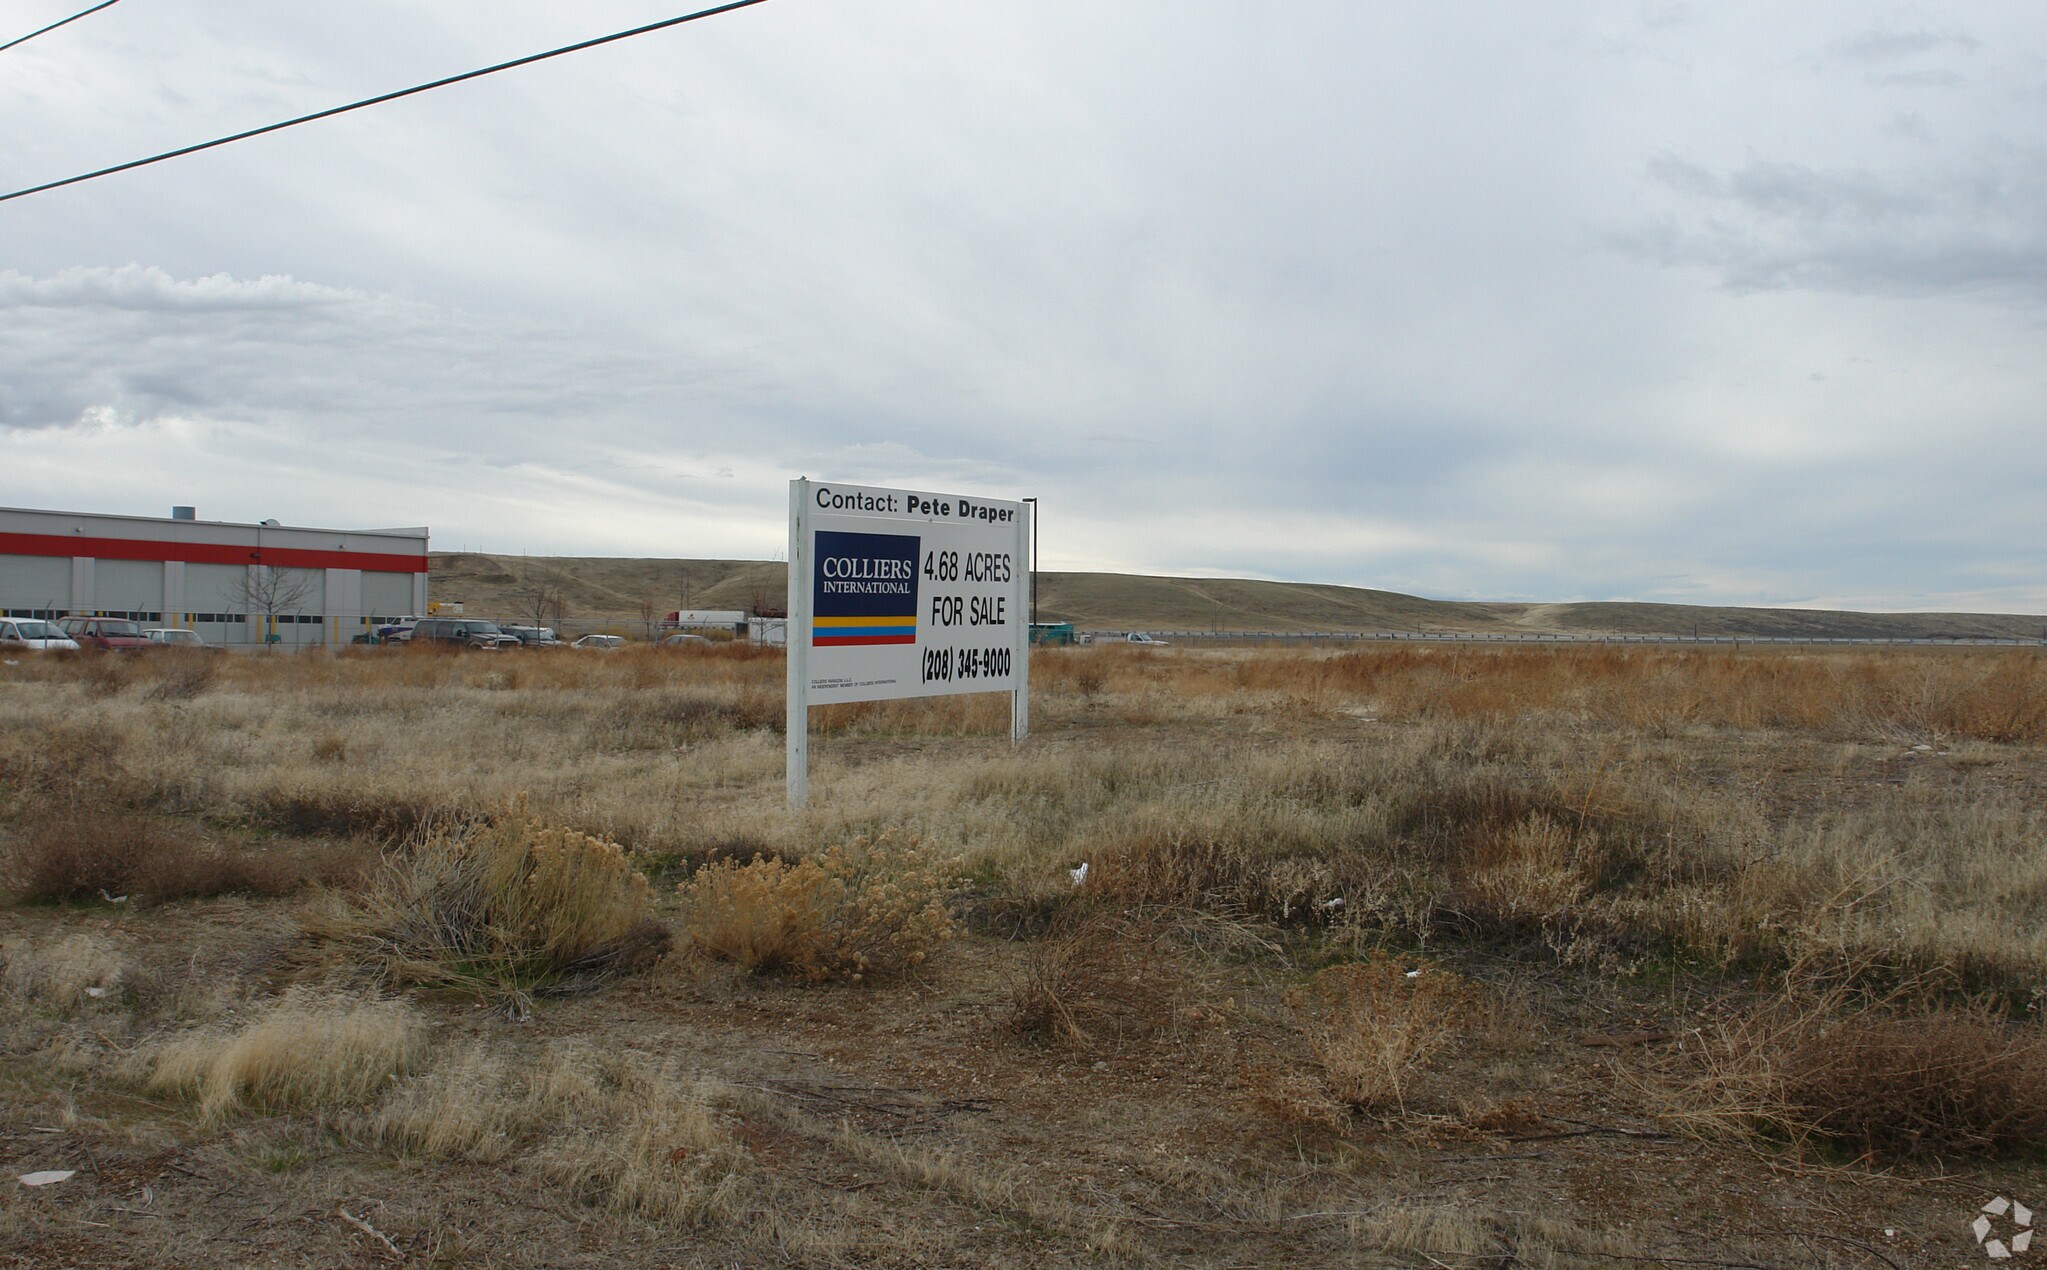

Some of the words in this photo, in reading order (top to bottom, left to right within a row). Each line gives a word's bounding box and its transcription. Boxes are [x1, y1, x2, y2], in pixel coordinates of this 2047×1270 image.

[816, 487, 898, 513] Contact:
[907, 495, 950, 516] Pete
[958, 500, 1014, 523] Draper
[823, 557, 912, 580] COLLIERS
[924, 551, 958, 582] 4.68
[964, 552, 1011, 583] ACRES
[823, 581, 910, 594] INTERNATIONAL
[932, 596, 963, 626] FOR
[970, 596, 1005, 626] SALE
[922, 645, 953, 684] (208)
[958, 647, 1011, 678] 345-9000
